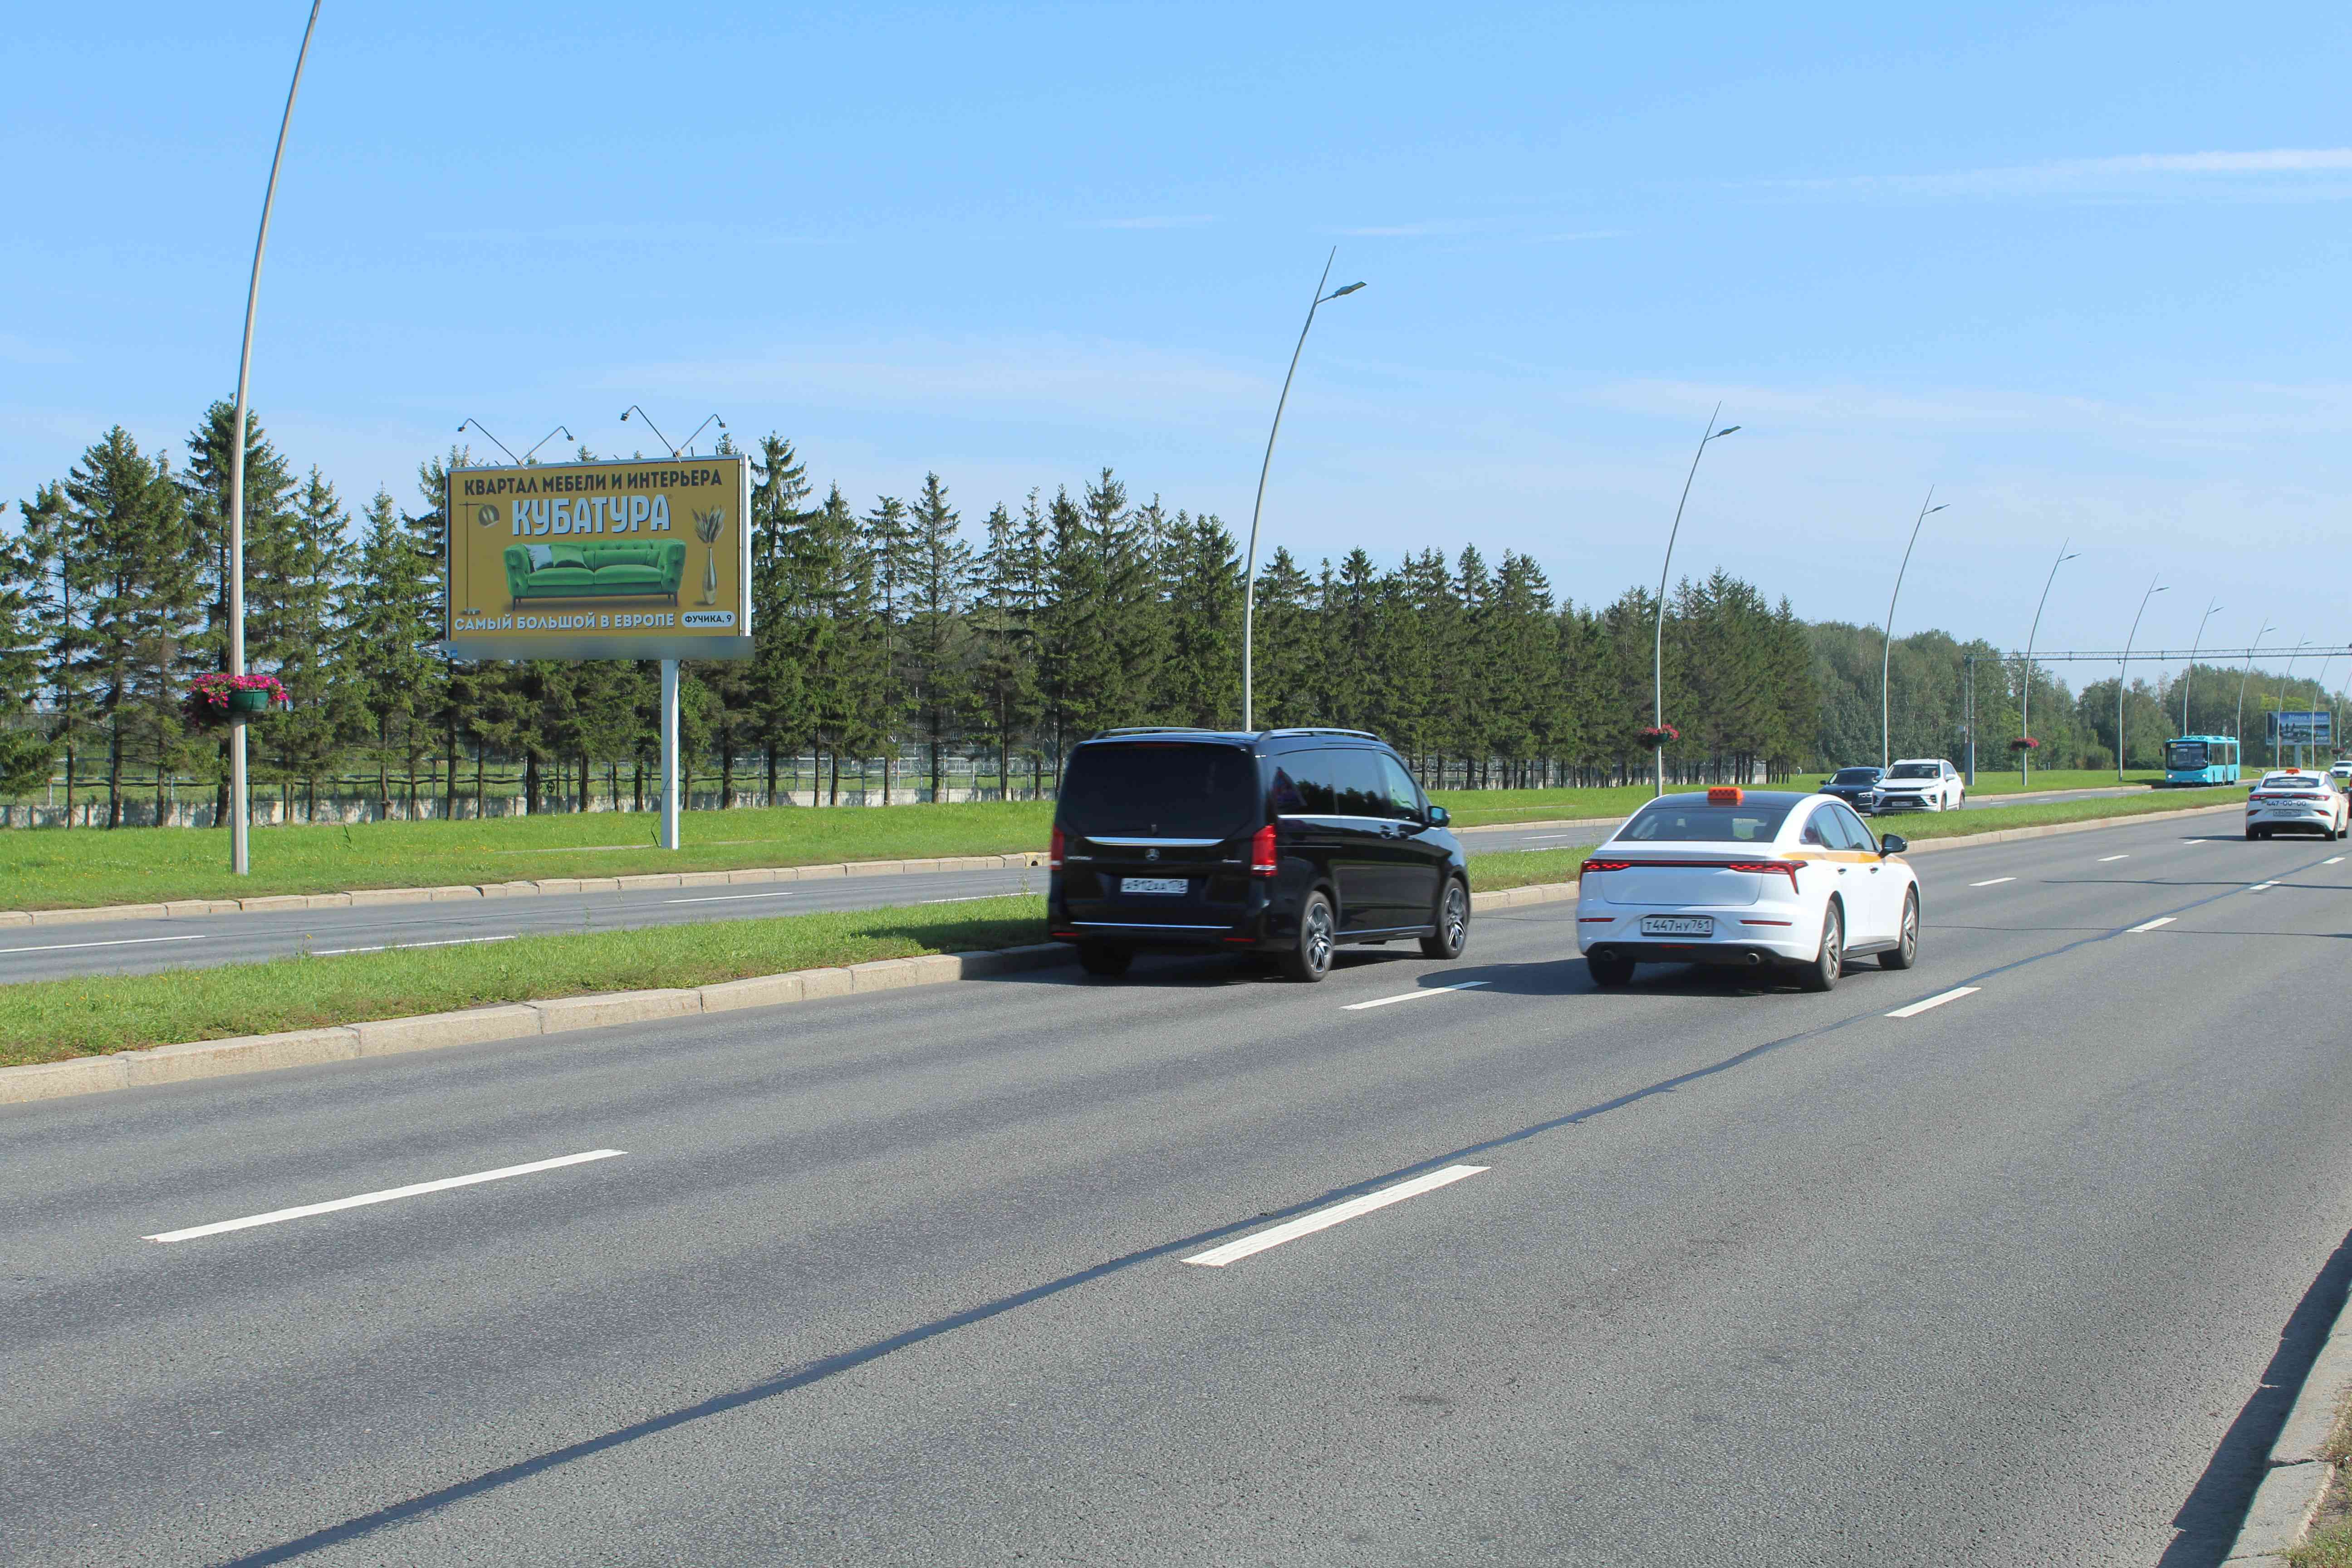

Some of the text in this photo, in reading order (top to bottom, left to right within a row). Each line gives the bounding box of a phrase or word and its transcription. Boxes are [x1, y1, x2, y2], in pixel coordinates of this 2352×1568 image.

[465, 469, 722, 495] КВАРТАЛ МЕБЕЛИ И ИНТЕРЬЕРА
[512, 494, 670, 536] КУБАТУРА
[454, 612, 675, 630] САМЫЙ БОЛЬШОЙ В ЕВРОПЕ
[685, 615, 725, 623] ФУЧИКА,
